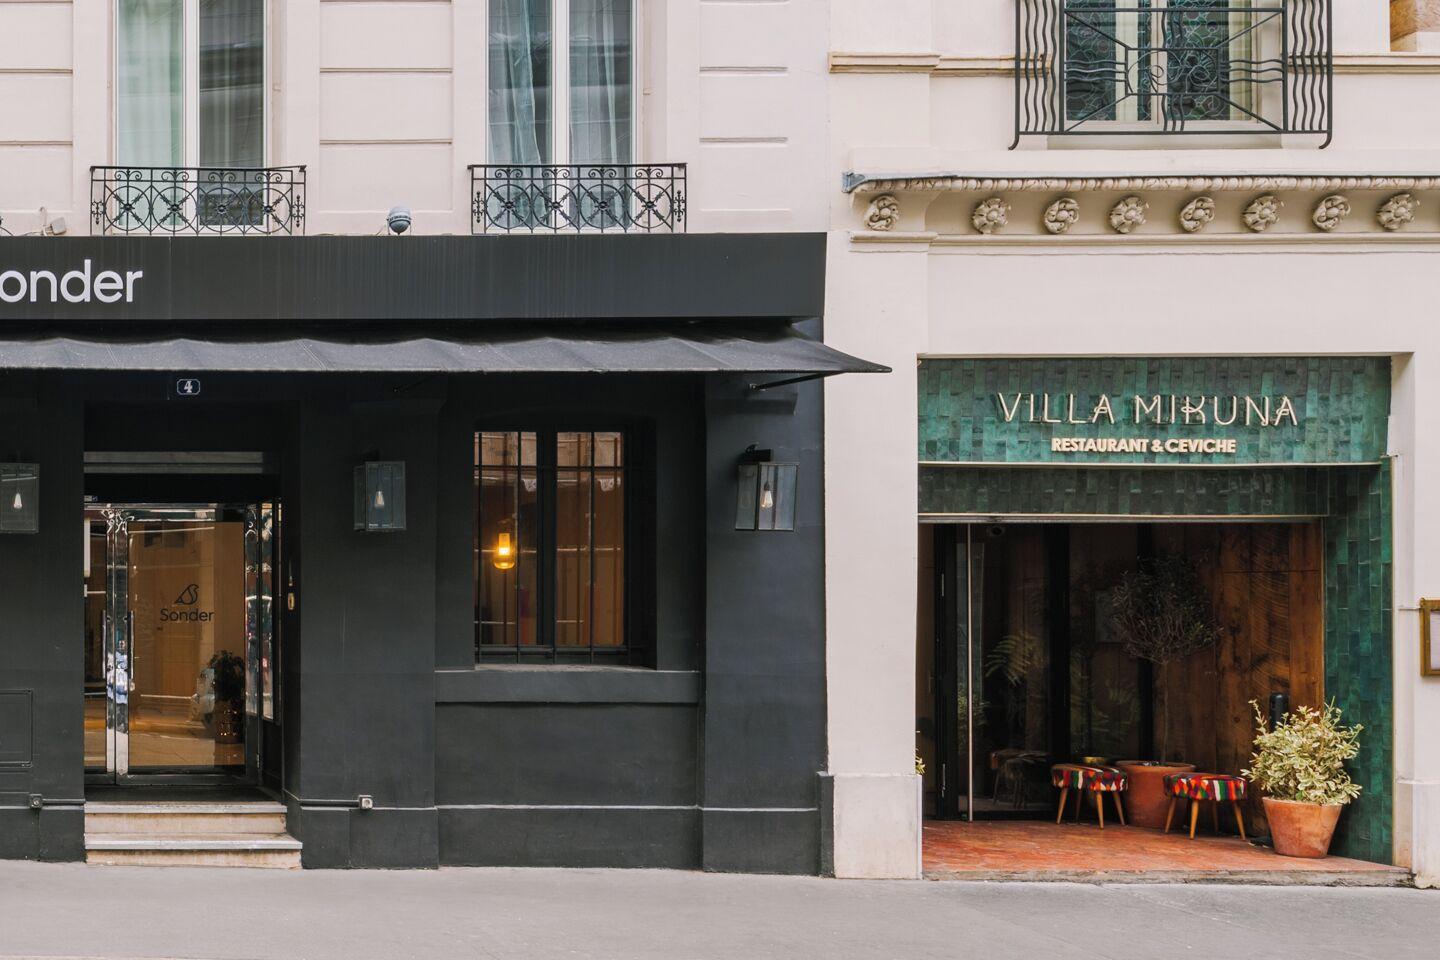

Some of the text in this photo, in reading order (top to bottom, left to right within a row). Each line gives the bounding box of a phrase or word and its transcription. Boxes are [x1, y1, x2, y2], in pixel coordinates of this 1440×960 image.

[183, 380, 193, 393] 4
[998, 392, 1298, 427] VILLA MIKUNA
[1051, 437, 1237, 453] RESTAURANT & CEVICHE
[160, 608, 215, 622] Sonder
